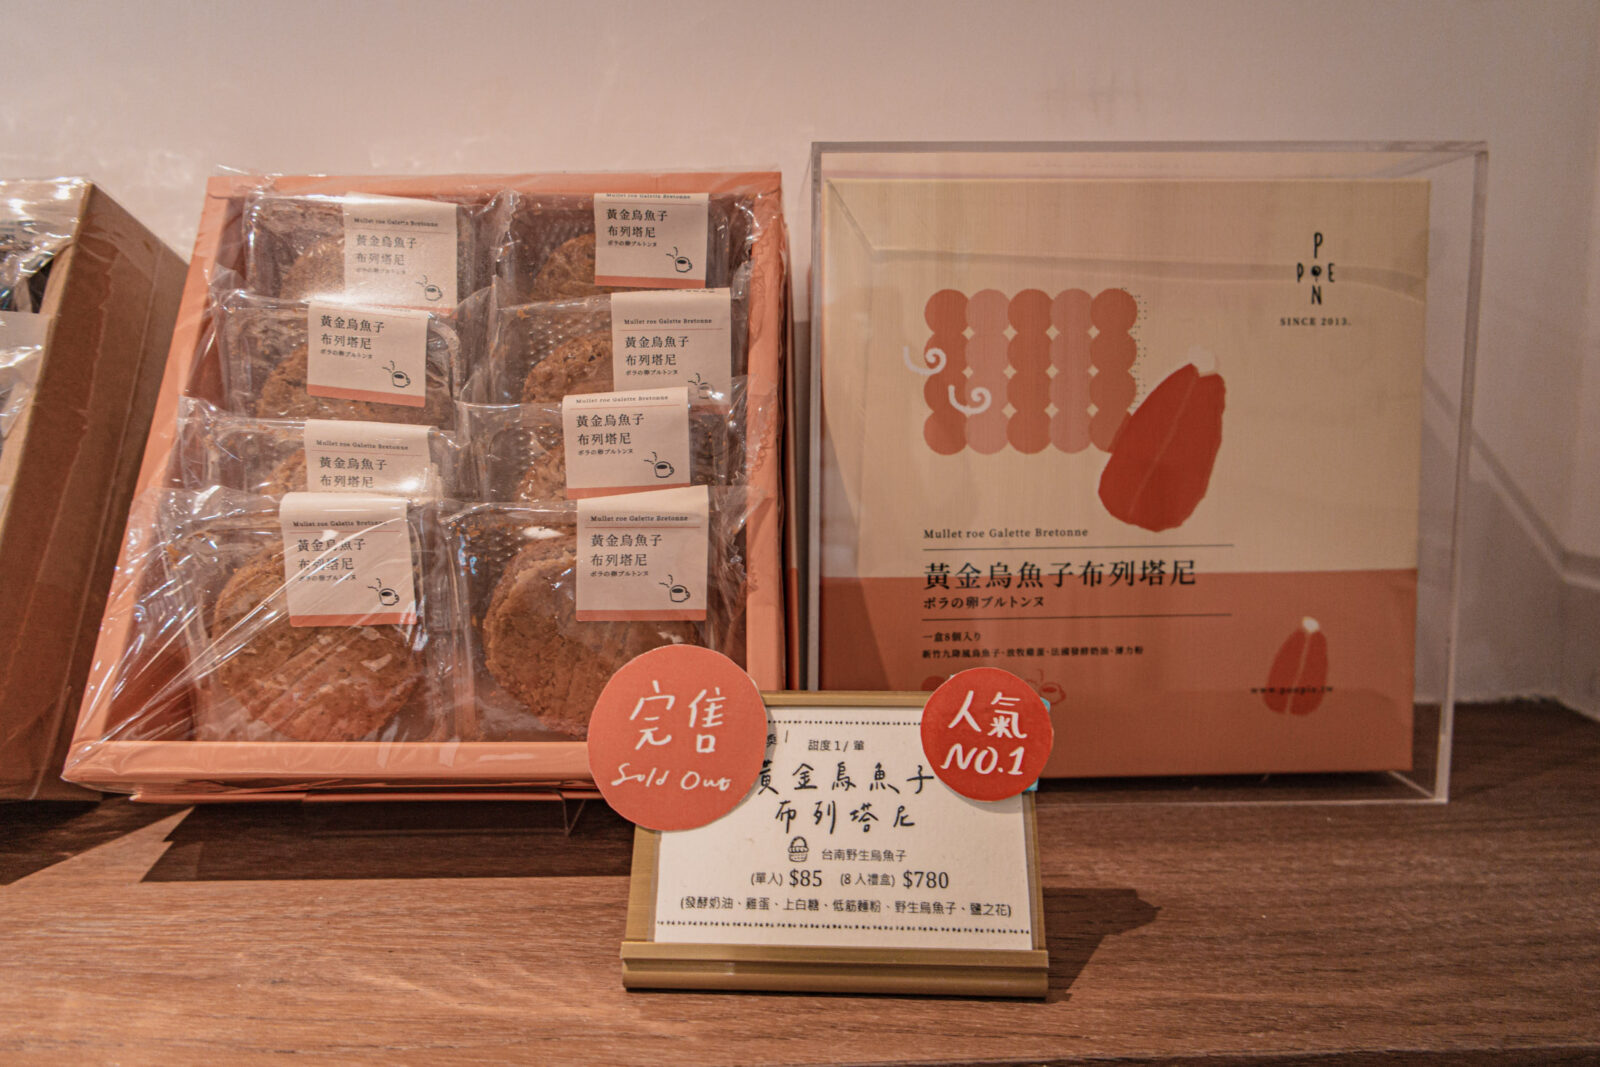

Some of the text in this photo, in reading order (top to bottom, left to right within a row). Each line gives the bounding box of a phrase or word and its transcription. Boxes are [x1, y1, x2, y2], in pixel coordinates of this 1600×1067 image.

[607, 208, 668, 222] 黃金烏魚子
[608, 226, 656, 238] 布列塔尼
[356, 234, 416, 248] 黃金烏魚子
[356, 253, 405, 266] 布列塔尼
[320, 315, 384, 333] 黃金烏魚子
[1280, 317, 1316, 326] SINCE
[321, 334, 372, 350] 布列塔尼
[625, 336, 688, 348] 黃金烏魚子
[626, 354, 676, 366] 布列塔尼
[576, 413, 644, 428] 黃金烏魚子
[578, 432, 632, 446] 布列塔尼
[320, 456, 387, 470] 黃金烏魚子
[320, 474, 374, 488] 布列塔尼
[924, 528, 1088, 538] Mullet roe Galette Bretonne
[591, 534, 662, 547] 黃金烏魚子
[590, 554, 648, 567] 布列塔尼
[924, 560, 1196, 590] 黃金烏魚子布列塔尼
[924, 596, 1044, 609] ボラの卵ブルトンヌ
[629, 680, 727, 754] 完售
[948, 690, 1028, 739] 人氣
[940, 743, 1025, 776] NO.1
[611, 762, 731, 792] Sold Out
[758, 759, 934, 795] 黃金烏魚子
[775, 801, 915, 834] 布列塔尼
[822, 849, 906, 862] 台南野生烏魚子
[789, 868, 822, 888] $85
[903, 870, 949, 890] $780
